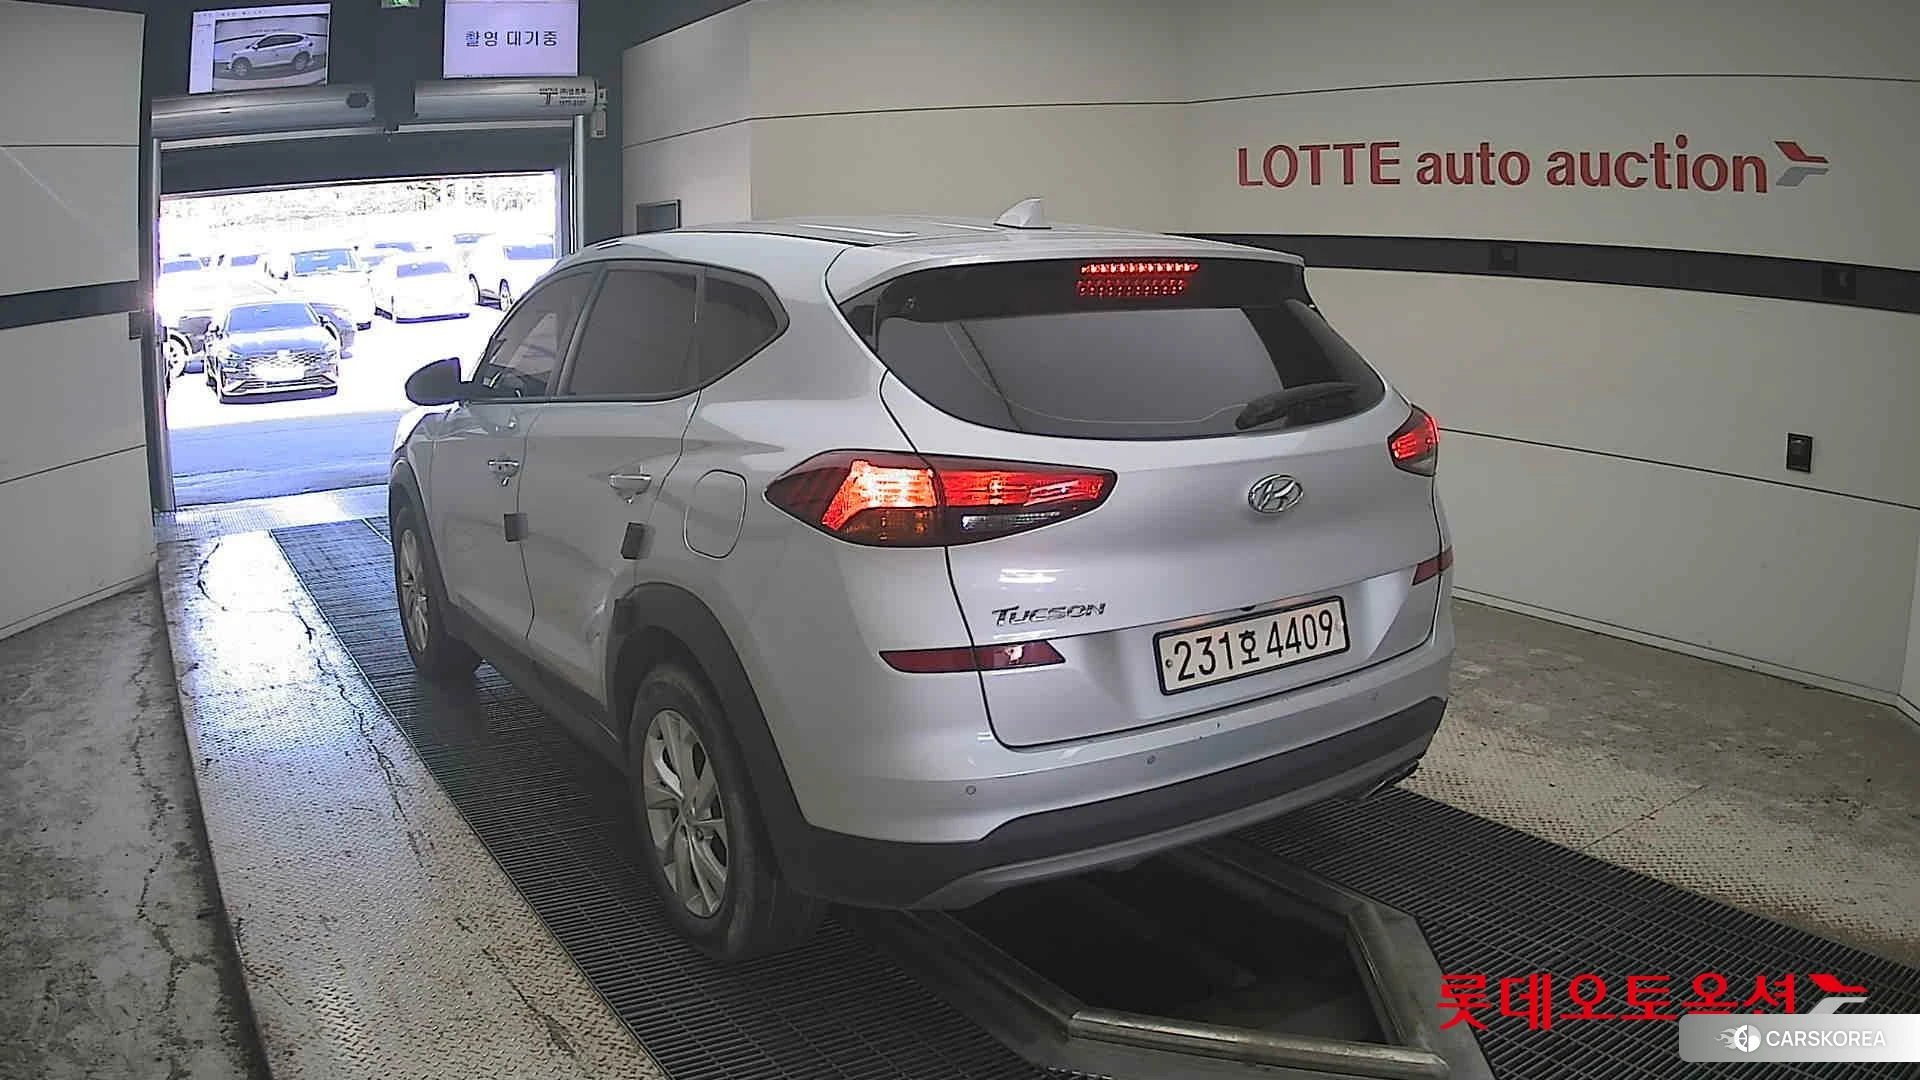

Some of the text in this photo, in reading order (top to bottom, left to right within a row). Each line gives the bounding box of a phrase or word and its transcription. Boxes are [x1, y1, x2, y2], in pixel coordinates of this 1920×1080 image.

[506, 30, 557, 47] 대기중
[1238, 134, 1769, 194] LOTTE auto auction
[991, 601, 1107, 627] TUCSON
[1266, 608, 1334, 658] 4409
